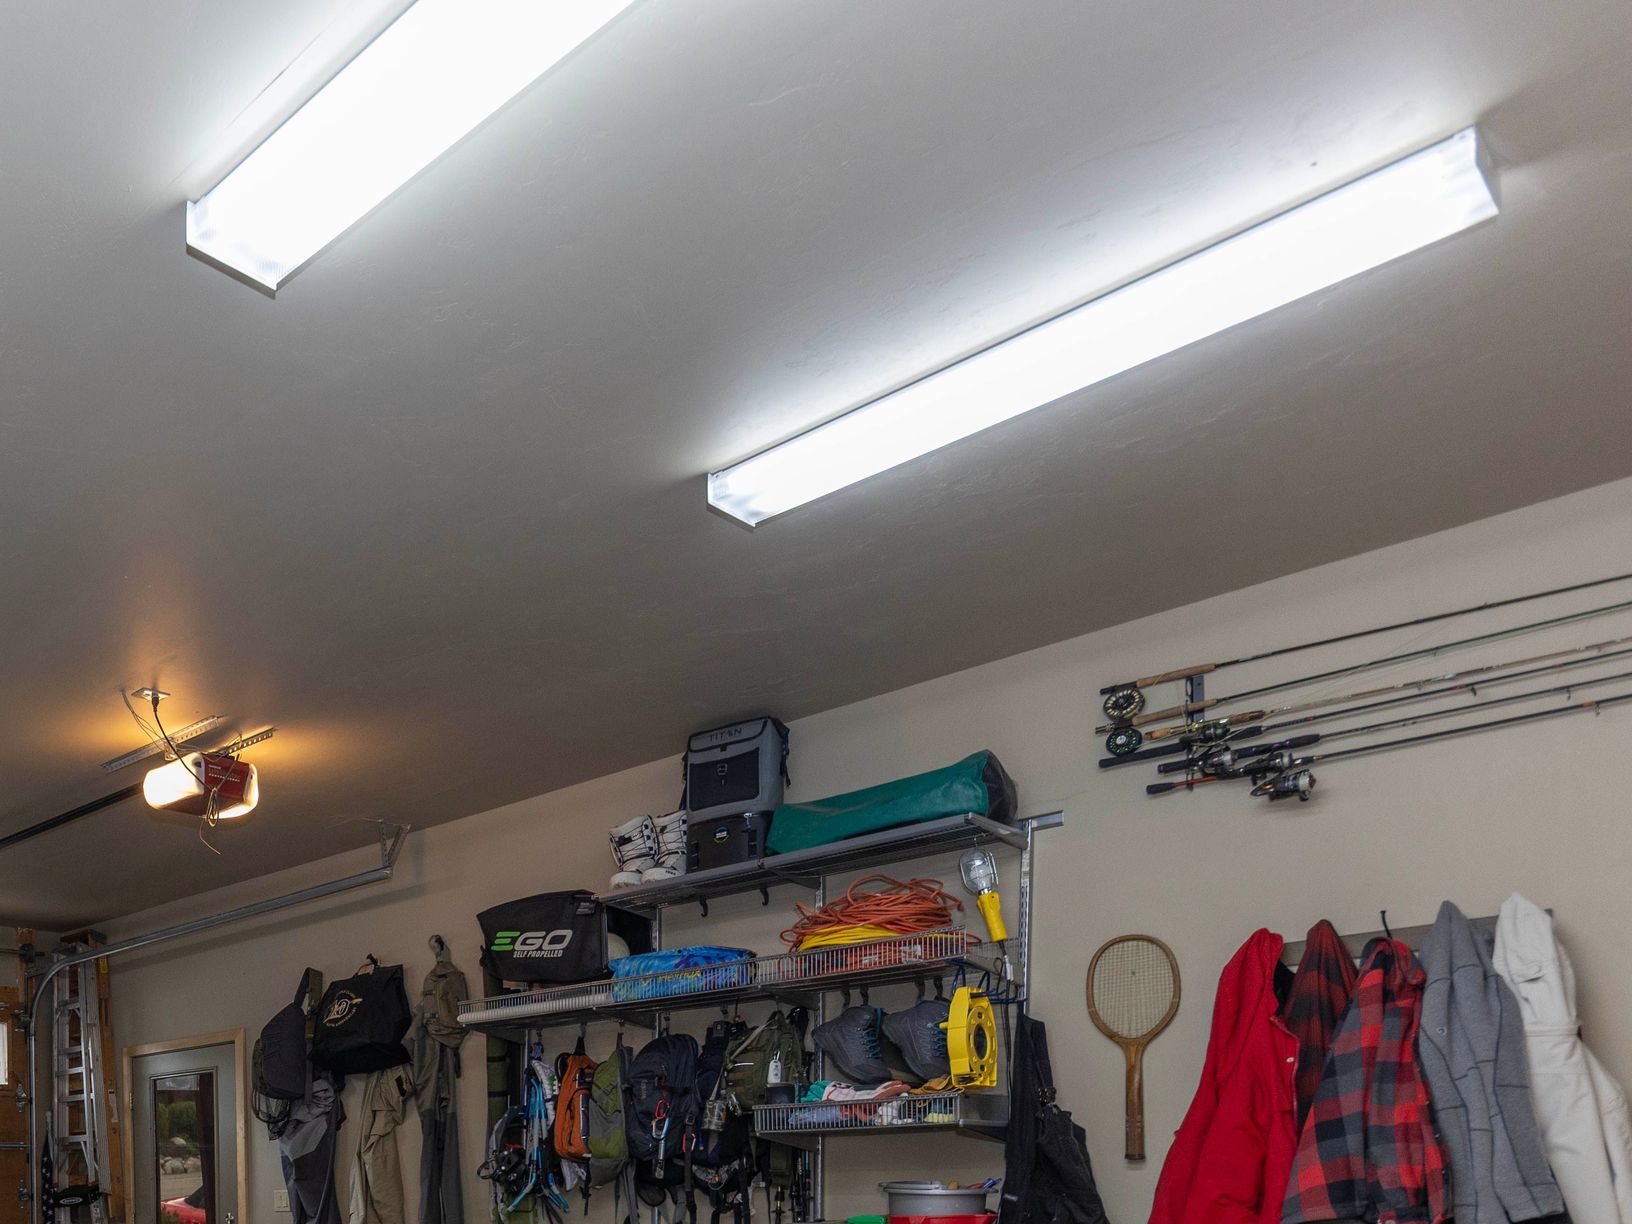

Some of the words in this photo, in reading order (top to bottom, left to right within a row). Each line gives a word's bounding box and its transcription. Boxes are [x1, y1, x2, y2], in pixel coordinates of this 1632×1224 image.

[491, 930, 573, 951] EGO
[513, 950, 528, 958] SELF
[528, 950, 563, 958] PROPELLED
